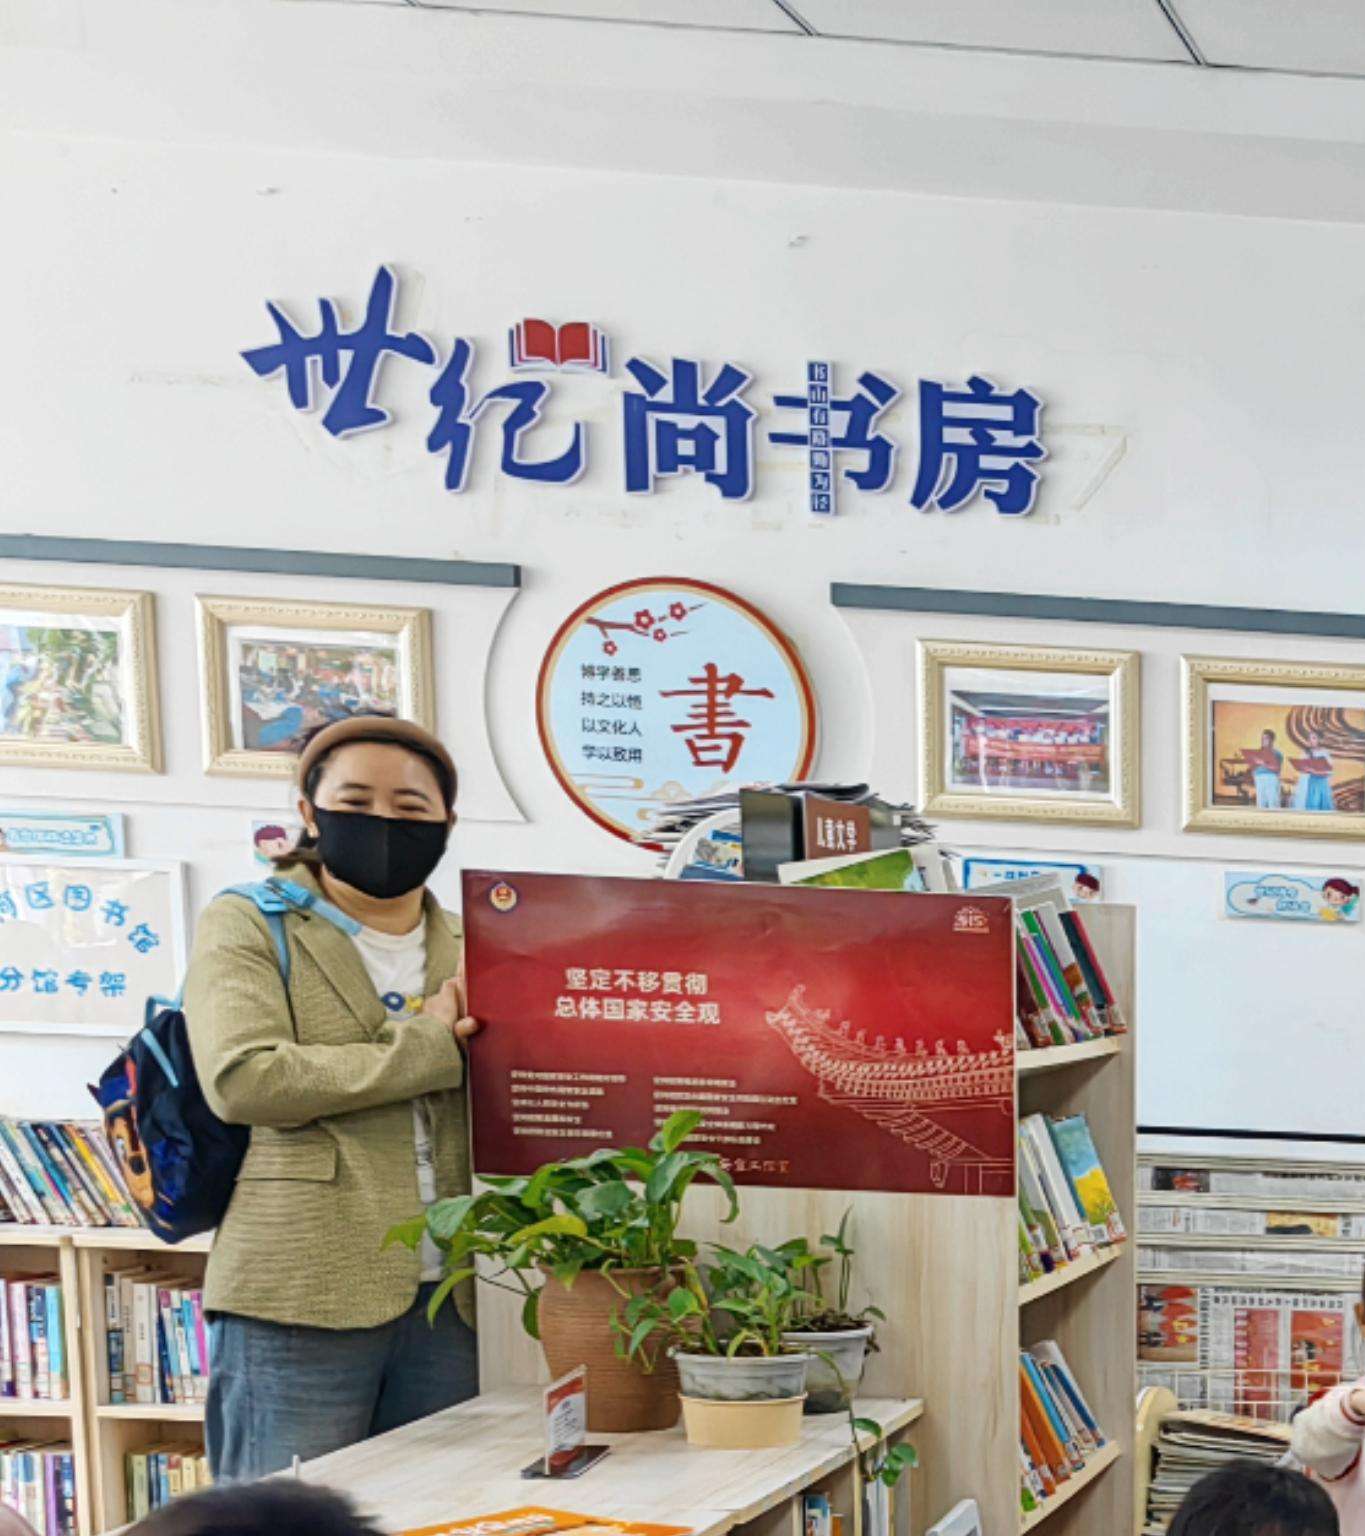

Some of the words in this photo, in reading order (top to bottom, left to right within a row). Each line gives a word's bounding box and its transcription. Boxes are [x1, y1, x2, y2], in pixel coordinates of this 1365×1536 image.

[241, 264, 1047, 516] 世纪尚书房
[581, 691, 642, 710] 持之以恒
[581, 717, 643, 737] 以文化人
[658, 662, 775, 774] 書
[582, 744, 642, 763] 学以致用
[816, 816, 857, 853] 儿童文学
[565, 966, 709, 995] 坚定不移贯彻
[555, 996, 721, 1025] 总体国家安全观
